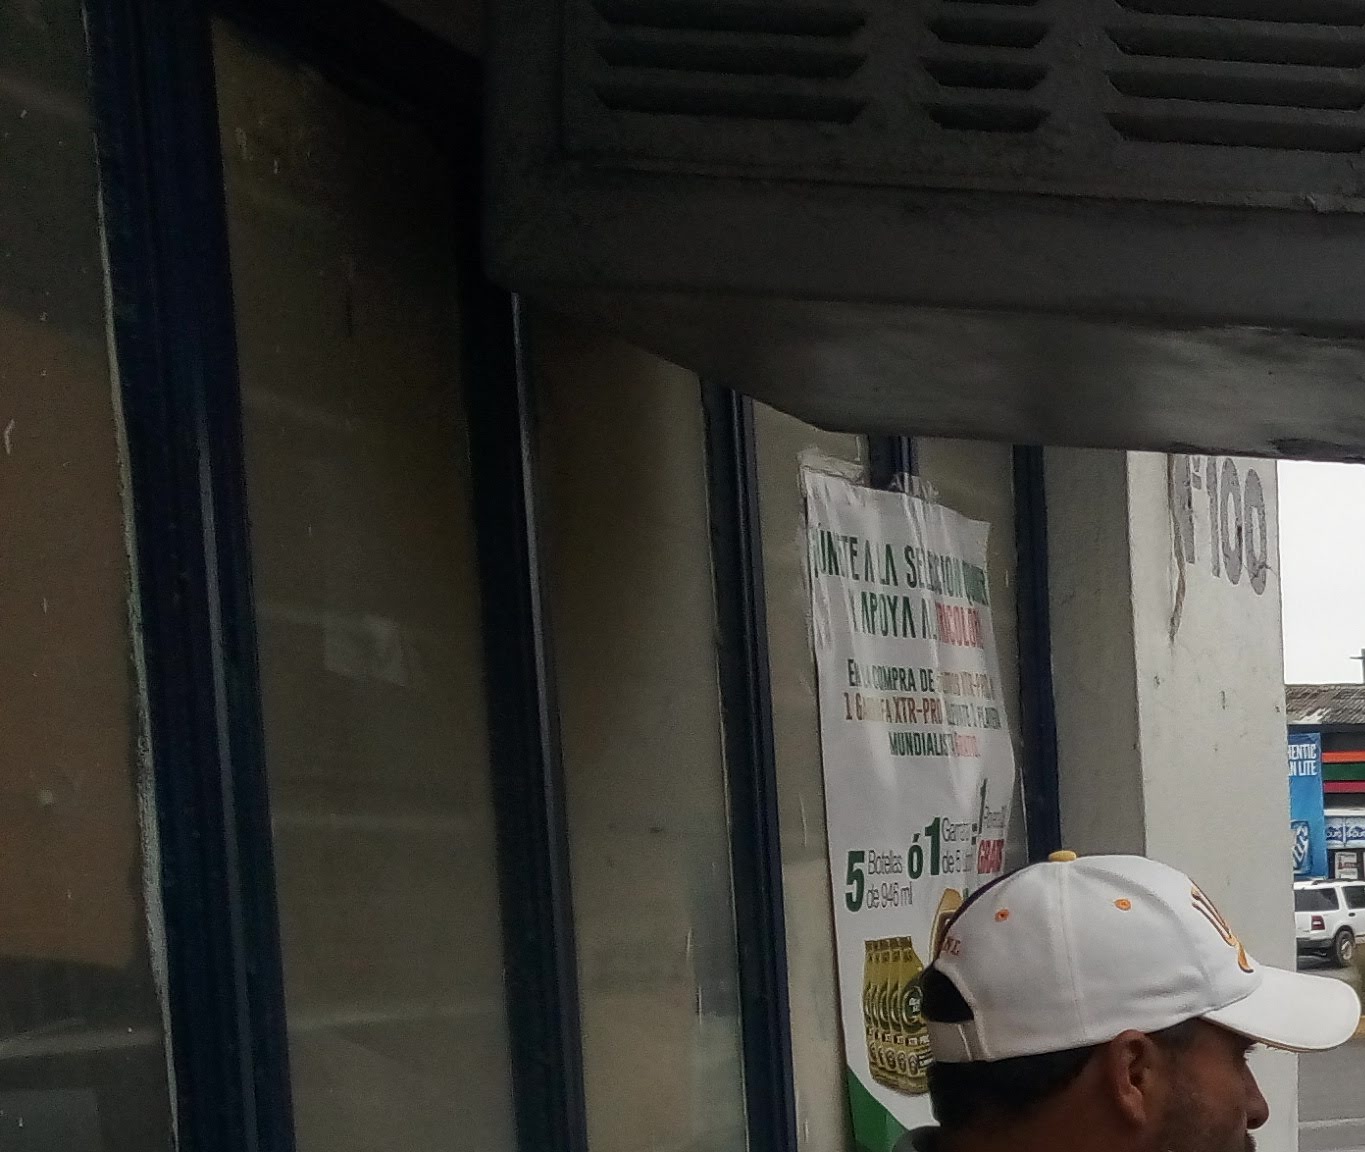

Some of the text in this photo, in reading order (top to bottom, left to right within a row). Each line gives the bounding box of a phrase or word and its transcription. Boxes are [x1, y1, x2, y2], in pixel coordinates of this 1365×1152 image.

[861, 591, 917, 639] APOYA
[871, 664, 917, 692] COMPRA
[920, 668, 936, 693] DE
[892, 696, 943, 725] XTR-PRO
[1299, 760, 1318, 776] LITE
[907, 832, 924, 880] ó
[924, 816, 941, 876] 1
[845, 849, 903, 912] 5 Botellas
[866, 885, 880, 909] de
[900, 880, 913, 905] ml
